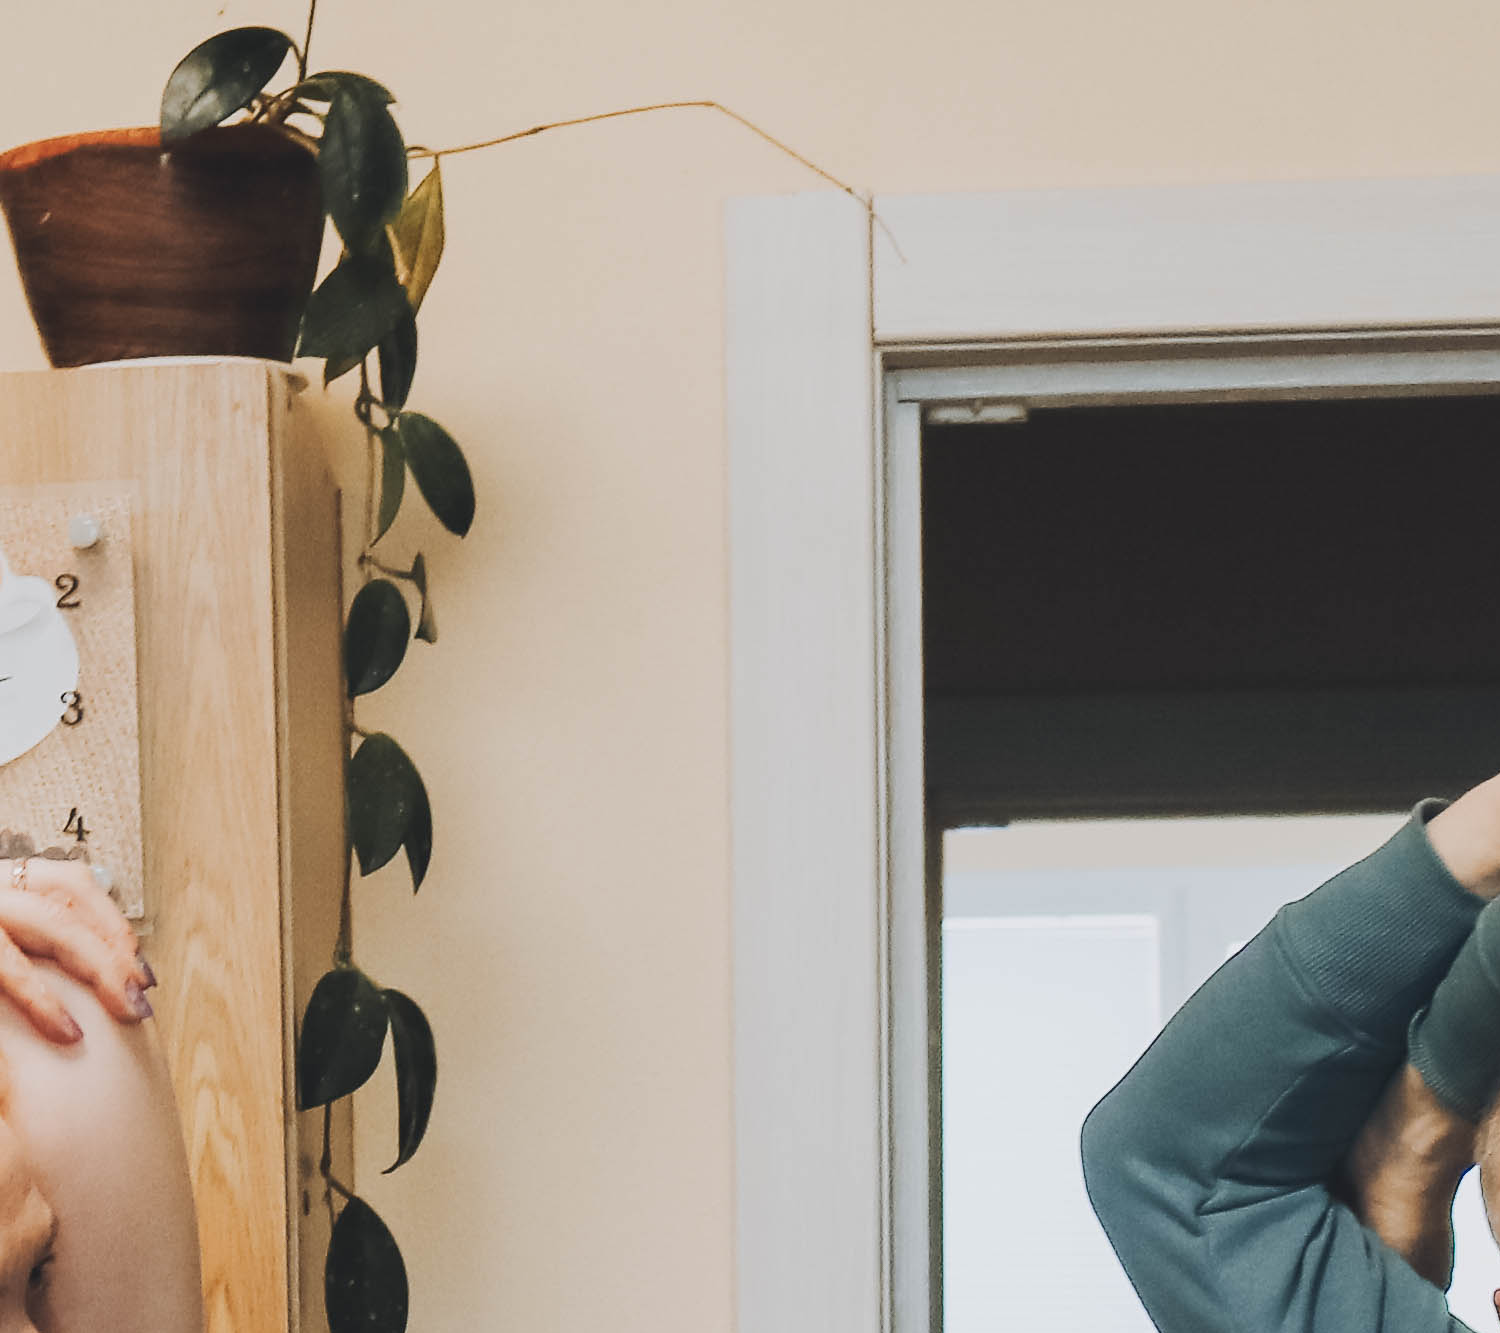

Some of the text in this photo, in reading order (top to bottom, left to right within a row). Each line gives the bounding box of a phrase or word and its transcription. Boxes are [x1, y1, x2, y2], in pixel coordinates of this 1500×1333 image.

[55, 574, 81, 609] 2
[60, 691, 83, 726] 3
[61, 807, 91, 843] 4
